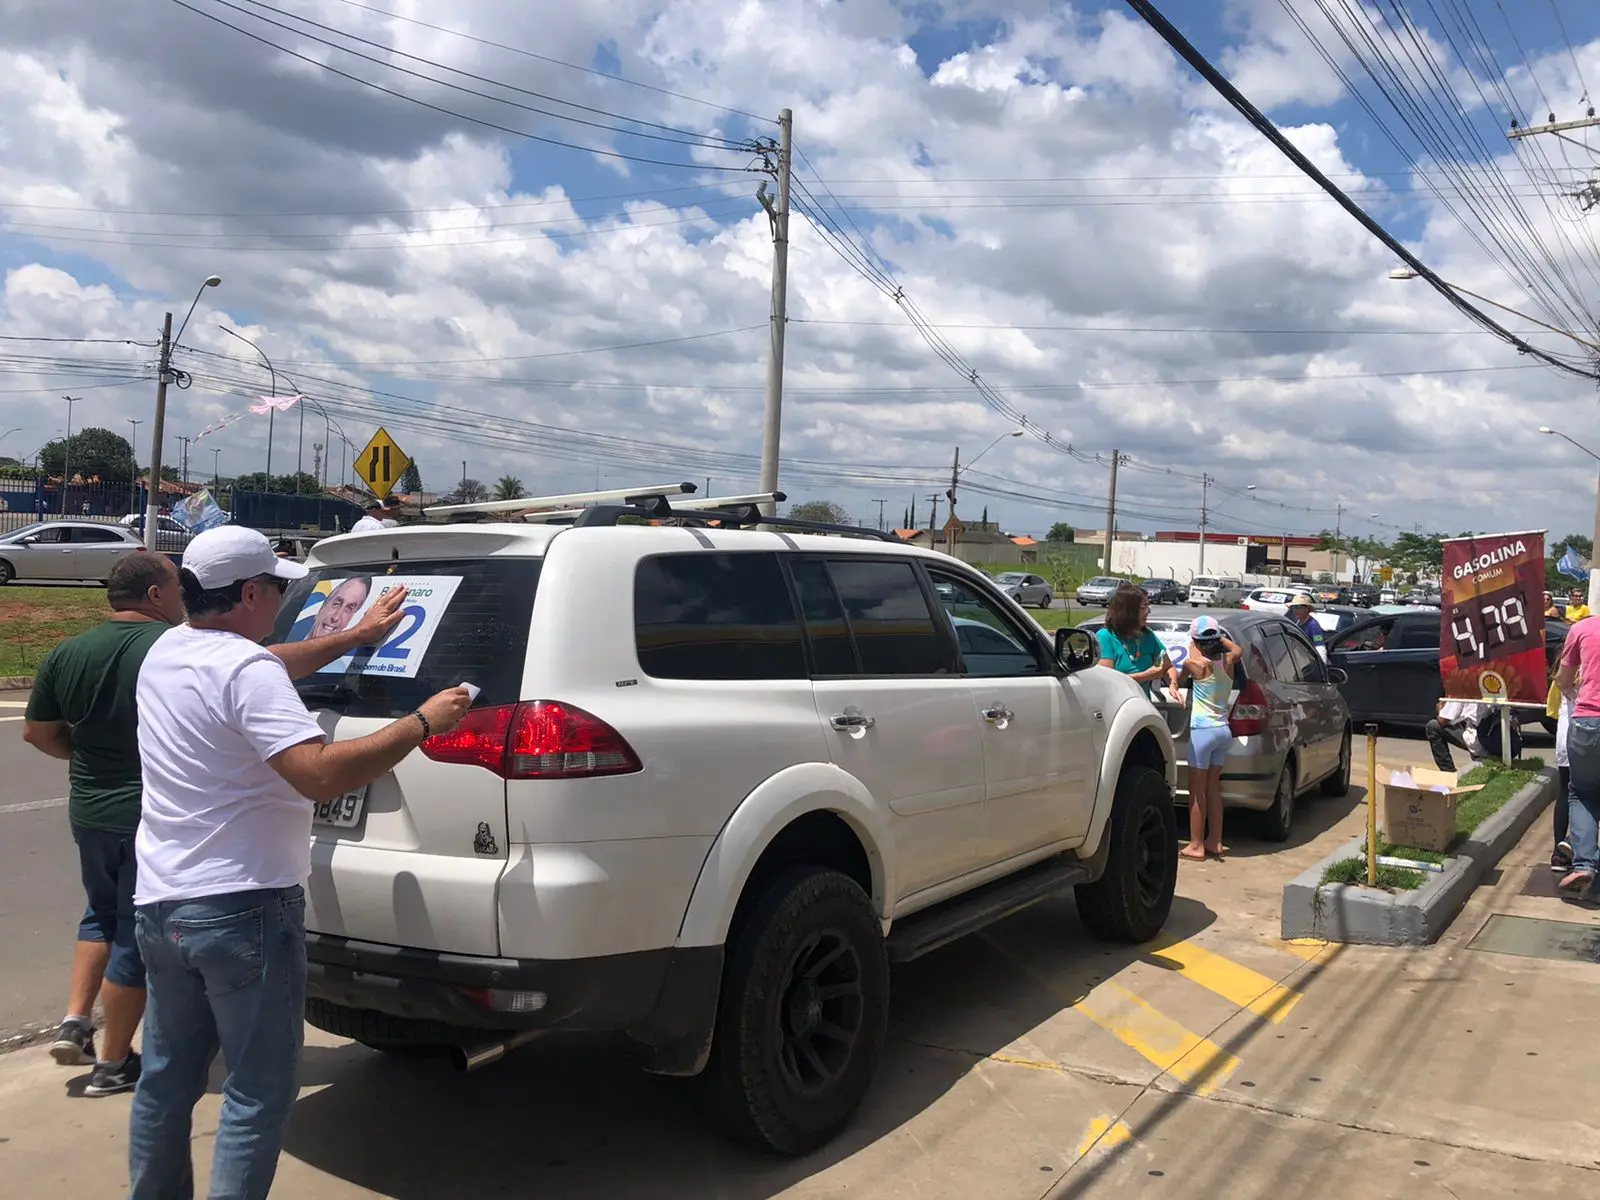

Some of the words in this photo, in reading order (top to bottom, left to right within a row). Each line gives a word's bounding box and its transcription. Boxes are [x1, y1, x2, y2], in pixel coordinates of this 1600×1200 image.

[1453, 540, 1527, 579] GASOLINA
[1472, 568, 1504, 584] COMUM
[380, 586, 433, 598] Bnaro
[1451, 597, 1528, 659] 4,79
[363, 663, 377, 672] bem
